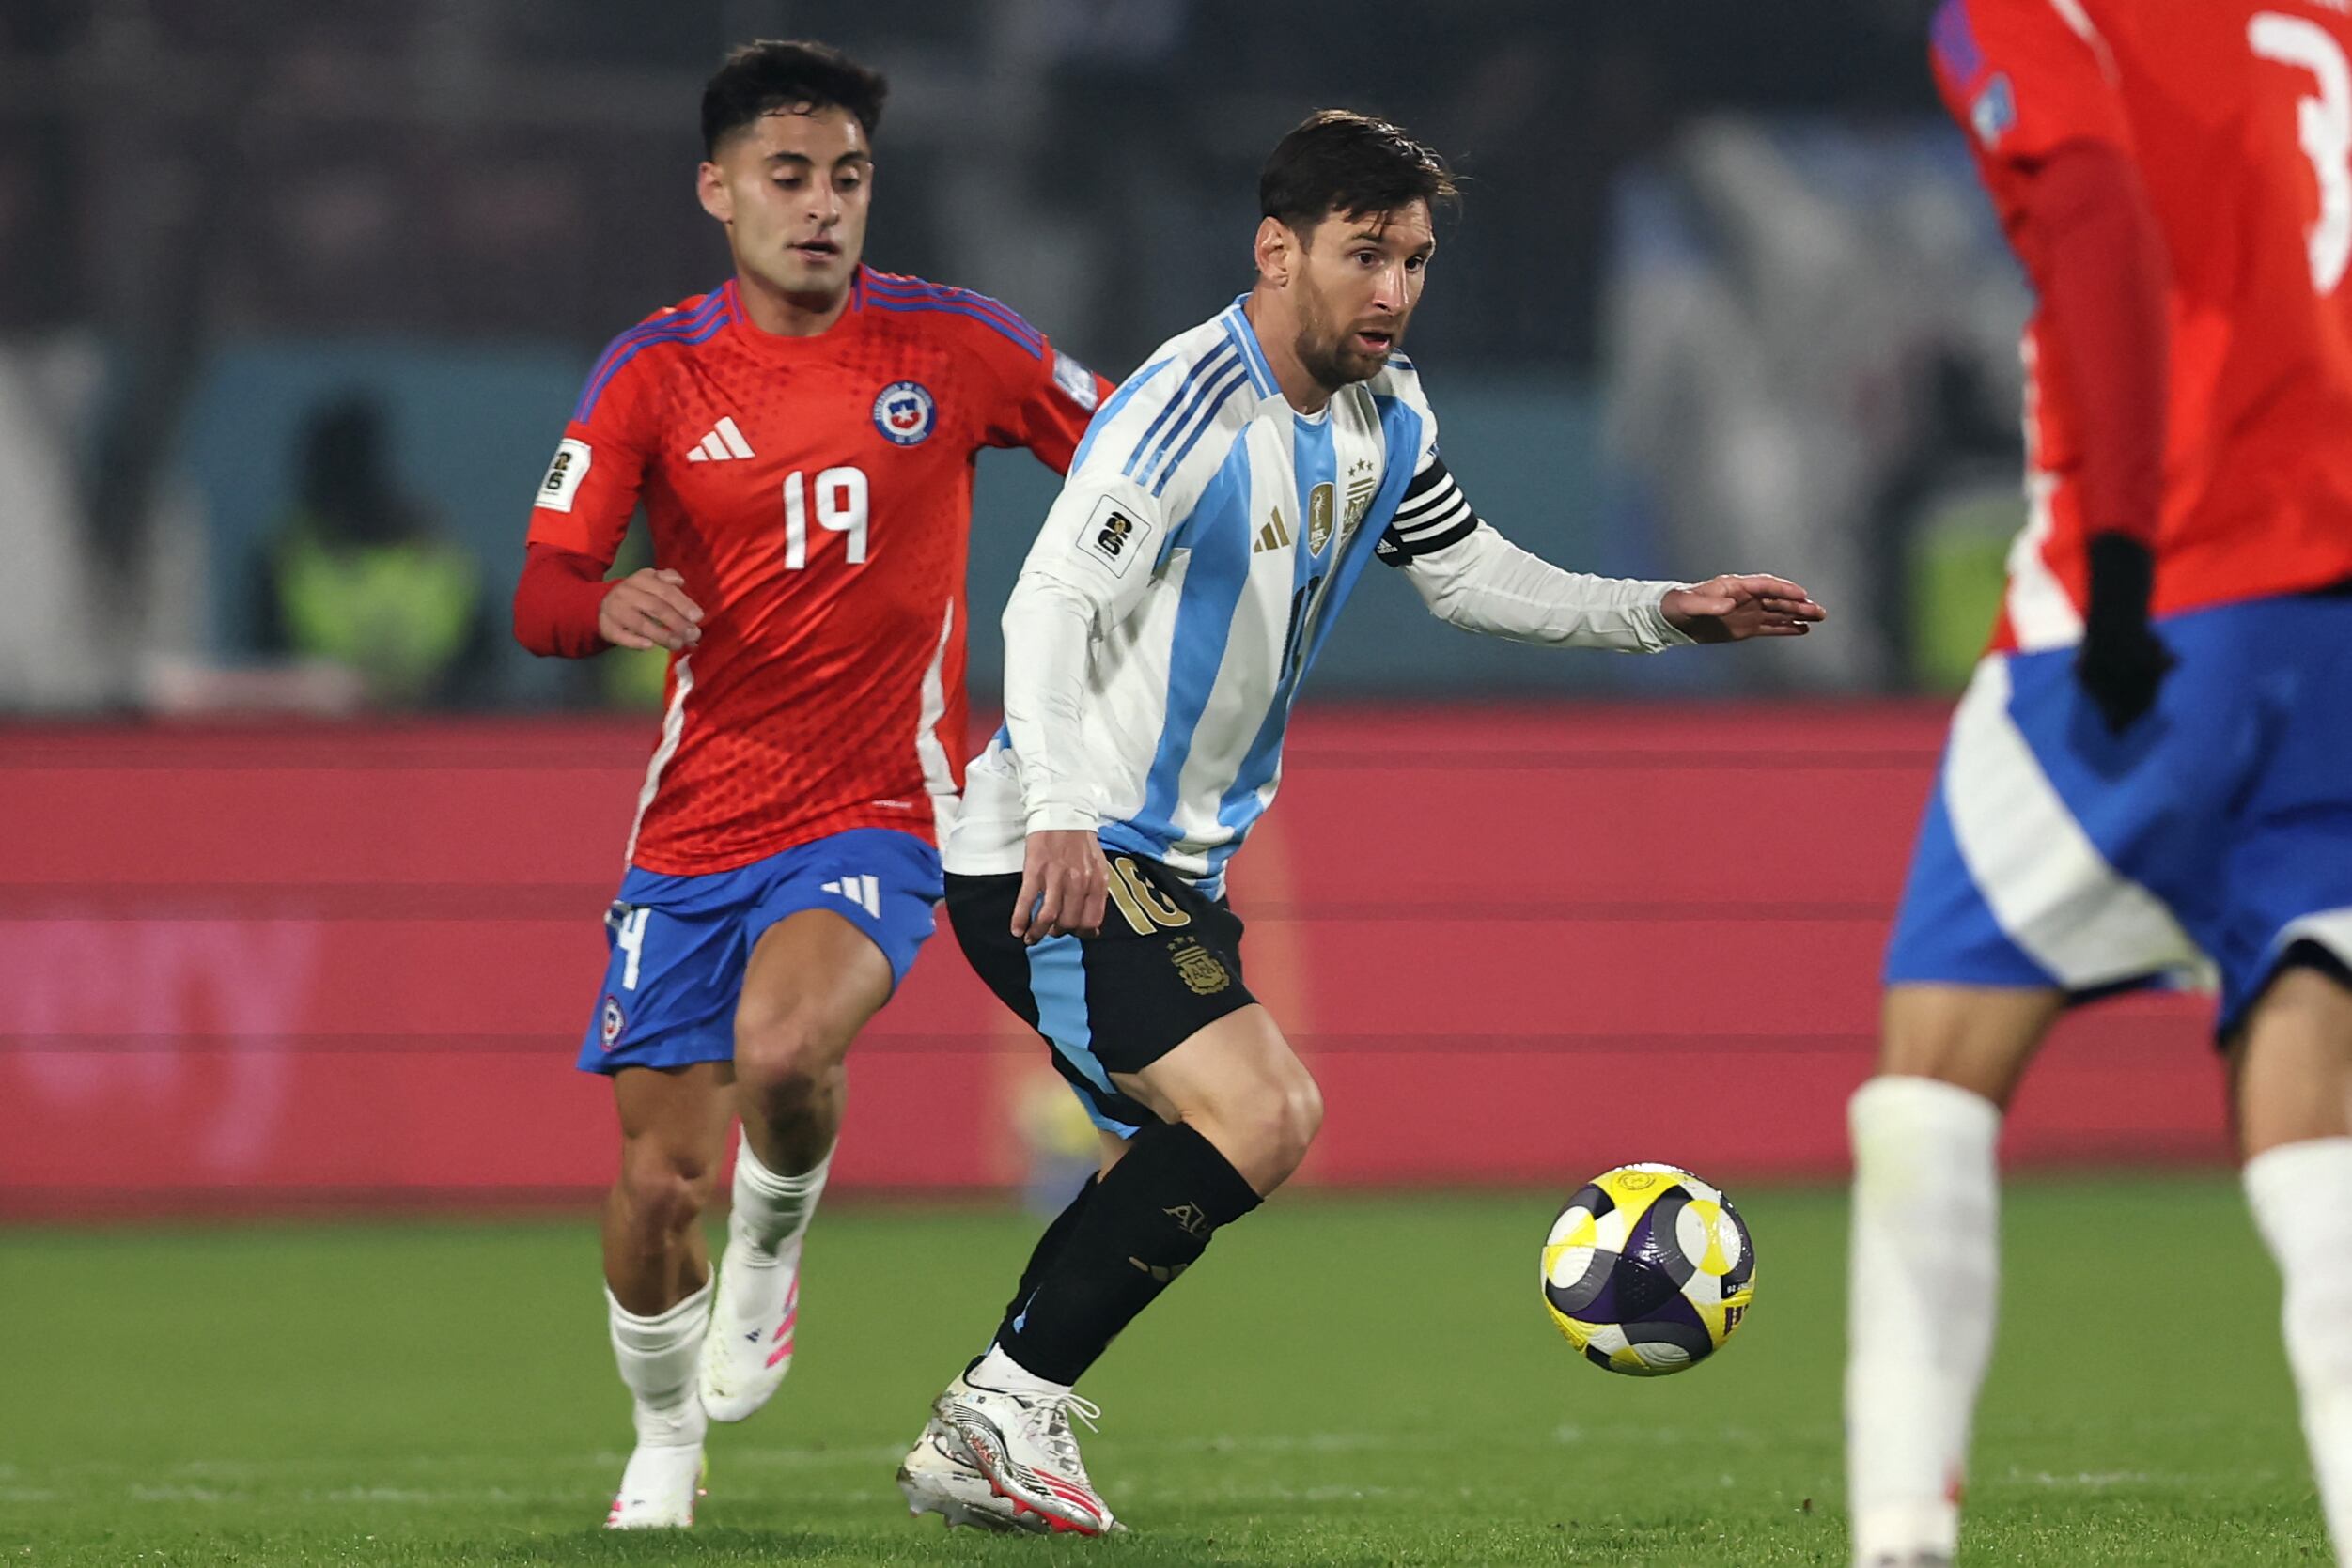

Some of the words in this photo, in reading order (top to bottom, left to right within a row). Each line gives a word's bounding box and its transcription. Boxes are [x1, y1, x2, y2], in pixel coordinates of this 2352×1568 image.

[2247, 11, 2352, 295] 3
[783, 466, 868, 569] 19
[1107, 856, 1192, 936] 10
